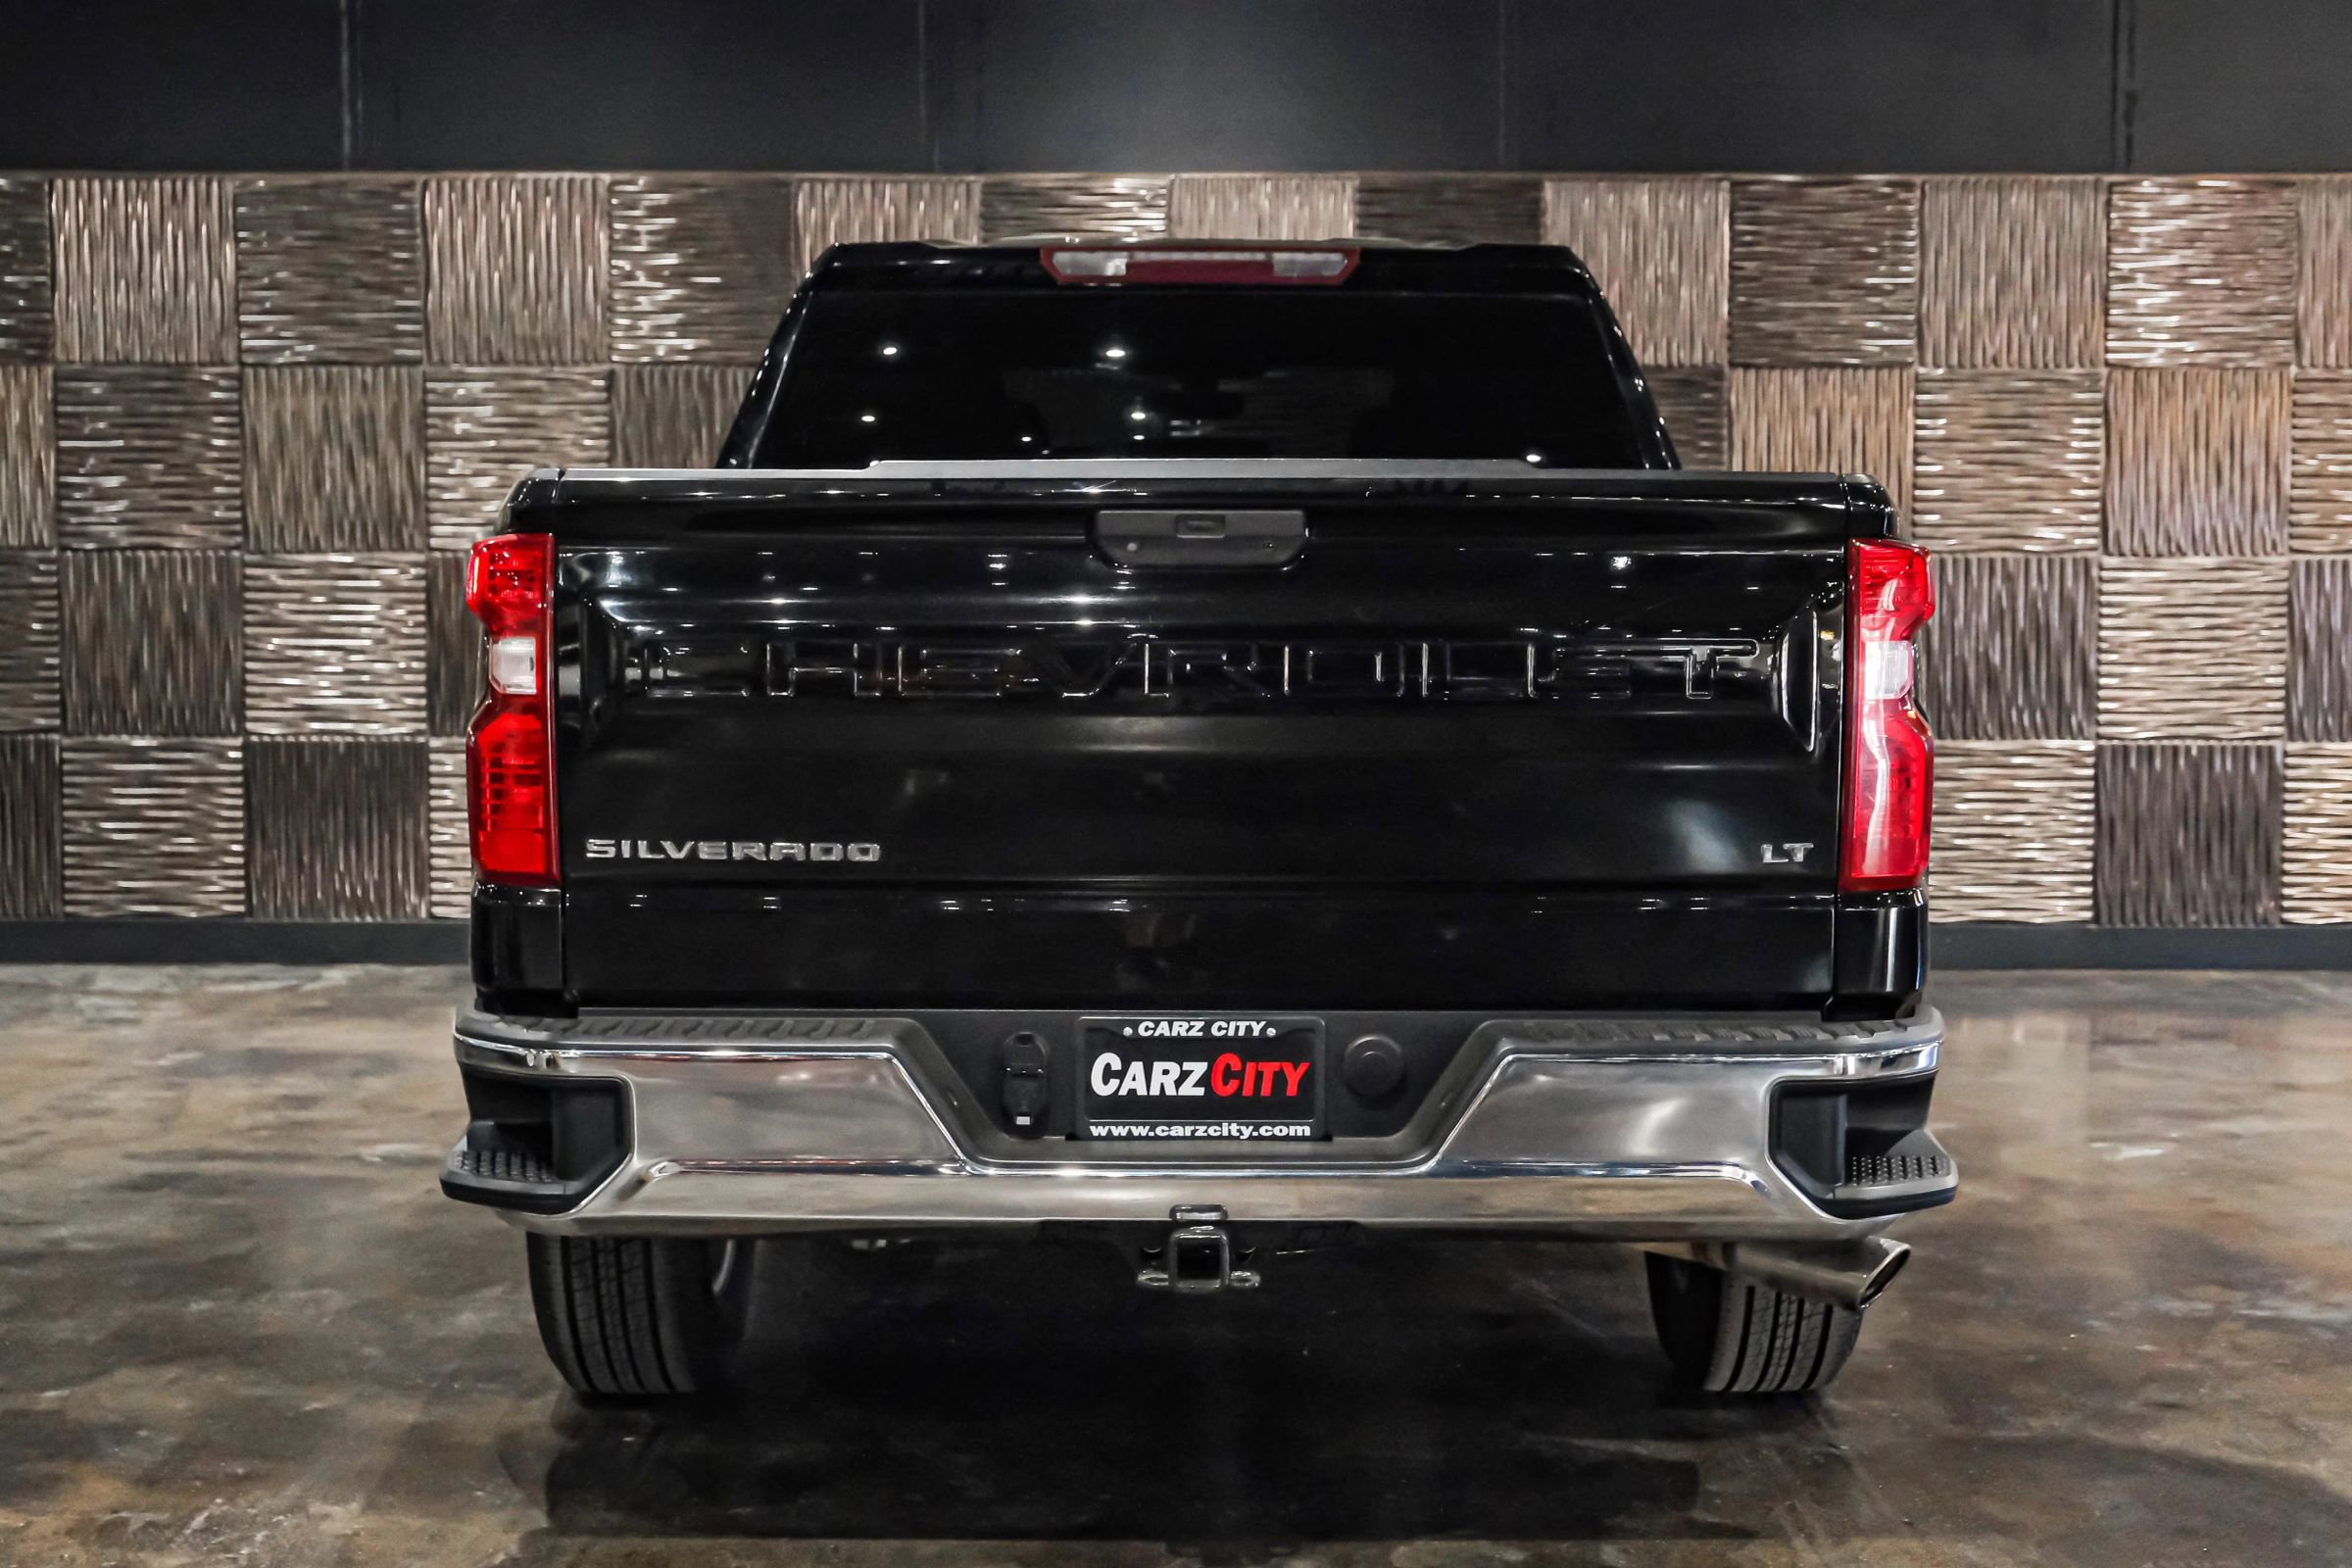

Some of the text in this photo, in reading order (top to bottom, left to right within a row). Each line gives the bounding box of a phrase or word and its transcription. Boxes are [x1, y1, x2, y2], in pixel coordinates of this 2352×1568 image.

[586, 839, 881, 861] SILVERADO
[1760, 843, 1814, 863] LT
[1138, 1021, 1267, 1037] CARZ CITY
[1090, 1123, 1310, 1137] www.carzcity.com
